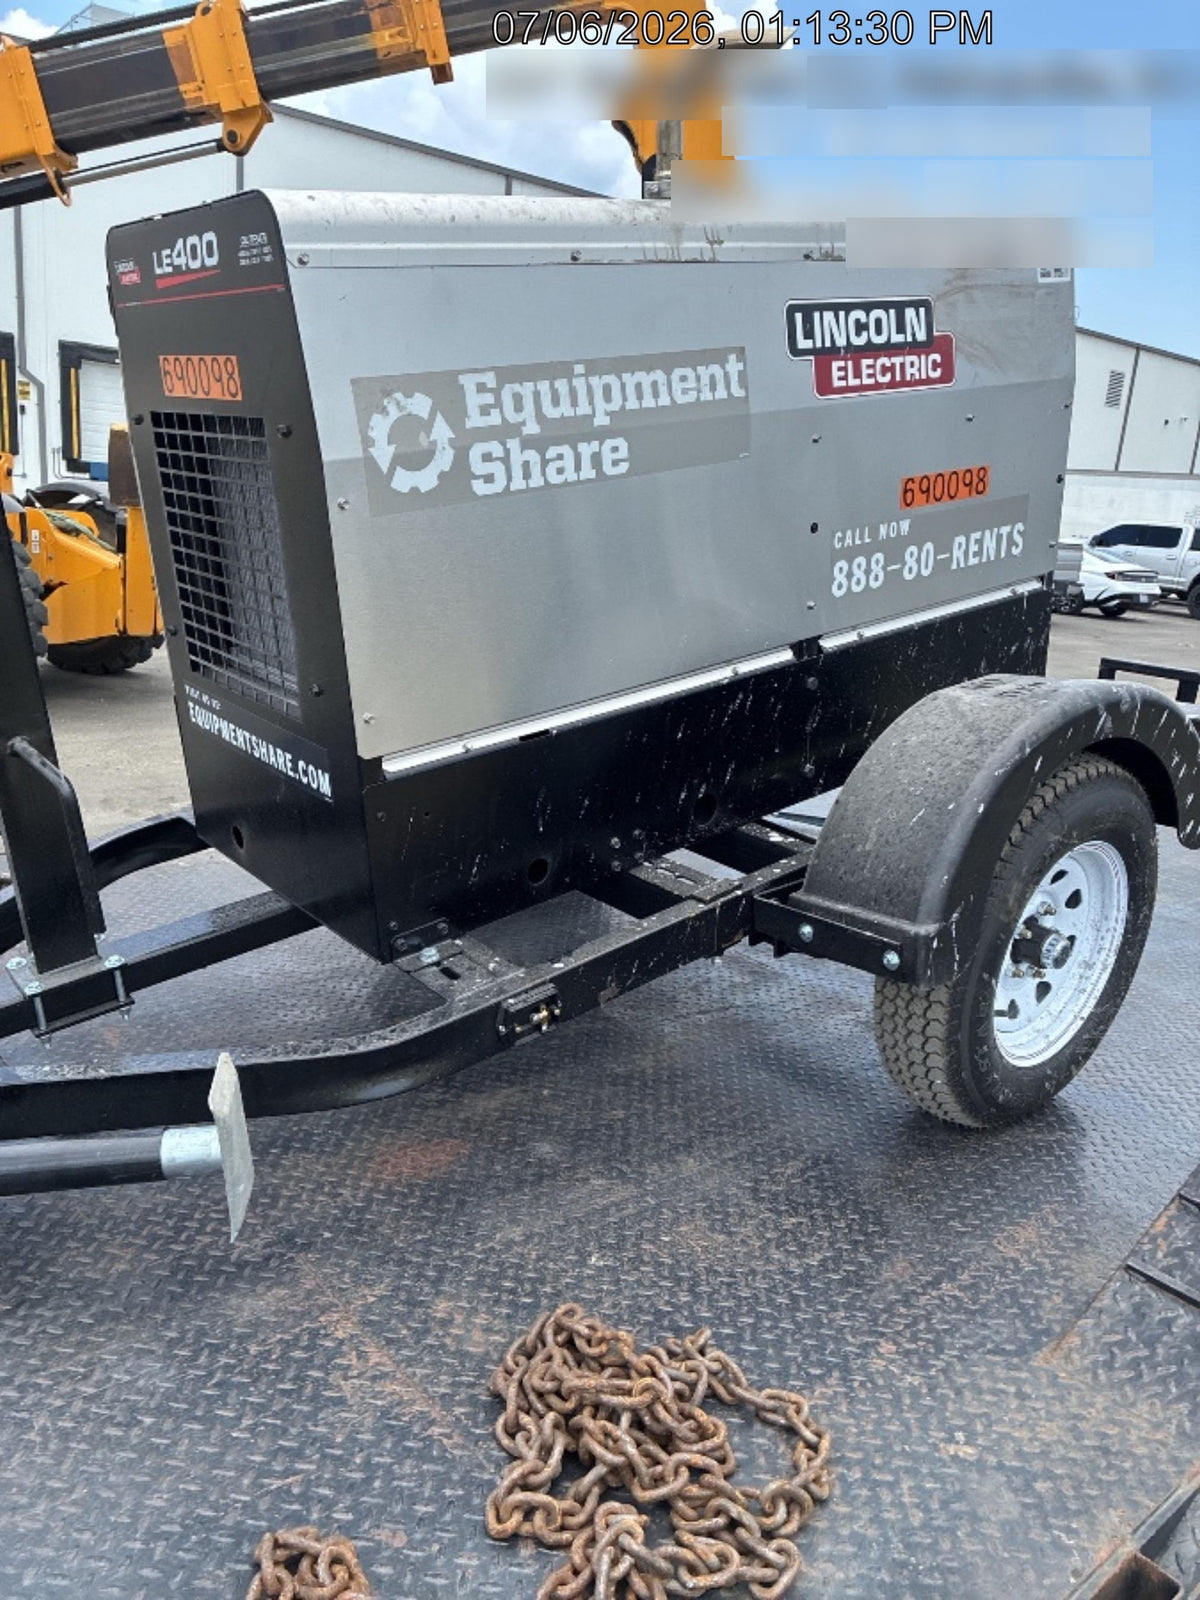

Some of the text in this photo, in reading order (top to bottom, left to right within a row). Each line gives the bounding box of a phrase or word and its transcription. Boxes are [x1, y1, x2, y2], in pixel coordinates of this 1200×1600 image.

[152, 231, 219, 275] LE400
[794, 307, 927, 350] LINCOLN
[162, 356, 239, 399] 690098
[831, 353, 942, 388] ELECTRIC
[459, 353, 746, 435] Equipment
[469, 436, 630, 496] Share
[902, 466, 988, 507] 690098
[834, 519, 911, 549] CALL NOW
[831, 522, 1025, 598] 888-80-RENTS
